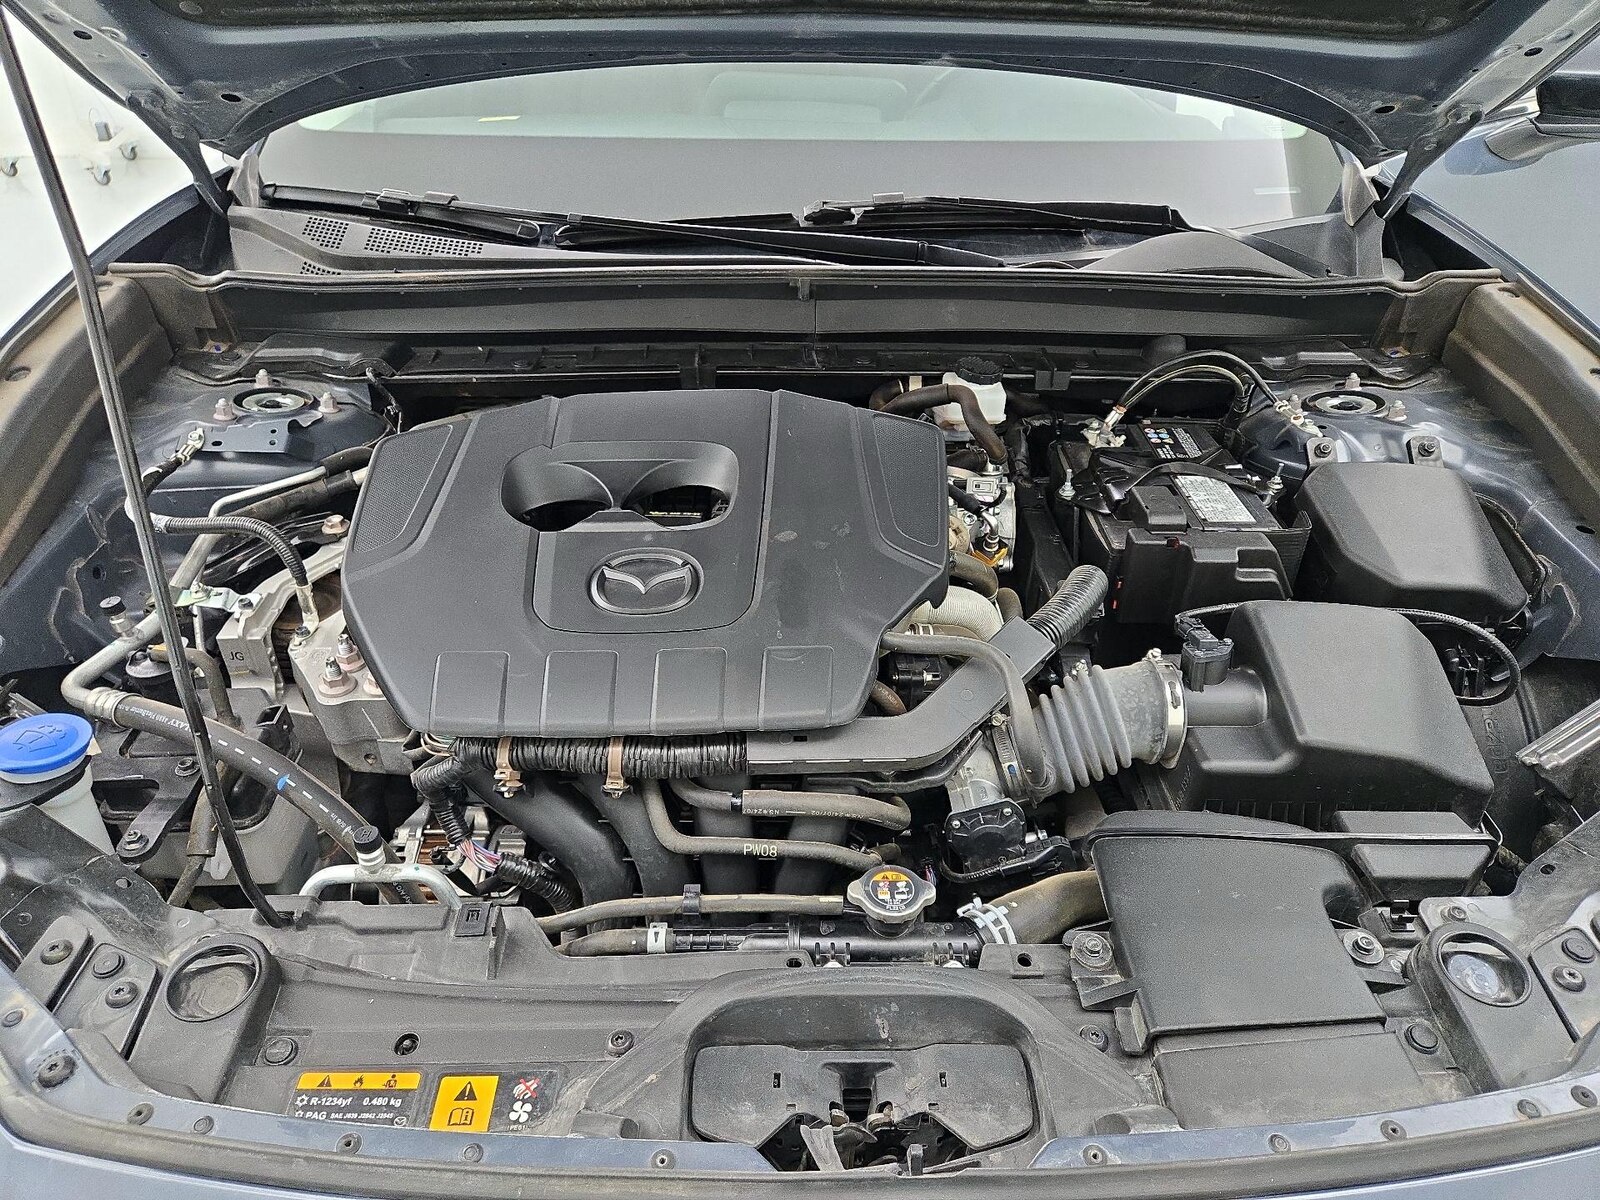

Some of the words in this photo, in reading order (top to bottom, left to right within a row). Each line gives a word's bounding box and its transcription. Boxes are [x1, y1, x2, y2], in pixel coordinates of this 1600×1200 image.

[230, 651, 244, 661] JG
[743, 843, 778, 857] PW08
[310, 1097, 353, 1107] R-1234yf
[362, 1097, 387, 1106] 0.480
[389, 1097, 402, 1107] kg
[305, 1111, 327, 1120] PAG
